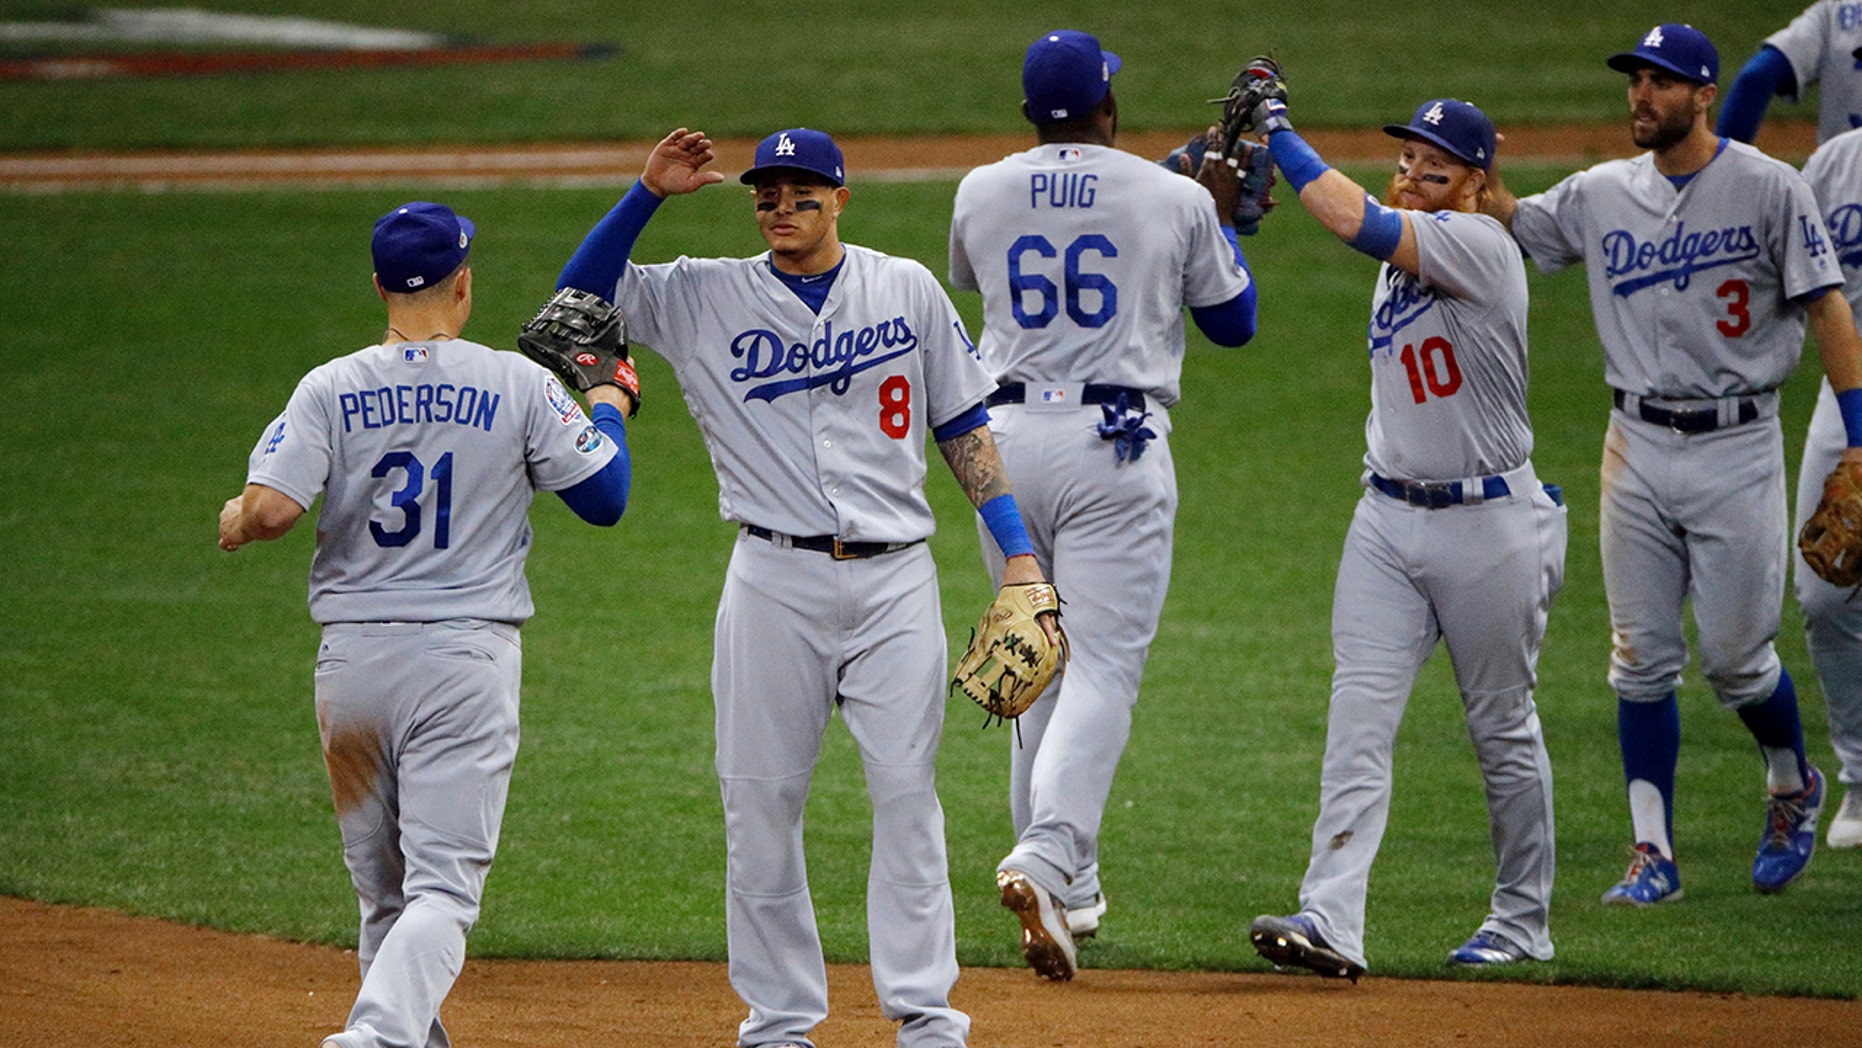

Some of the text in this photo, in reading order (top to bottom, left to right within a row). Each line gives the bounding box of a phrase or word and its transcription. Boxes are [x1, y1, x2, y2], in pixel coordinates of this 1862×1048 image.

[775, 132, 796, 156] LA
[1030, 173, 1099, 209] PUIG
[1602, 221, 1760, 298] Dodgers
[1798, 215, 1827, 257] LA
[1007, 233, 1118, 330] 66
[1716, 279, 1750, 337] 3
[730, 316, 918, 403] Dodgers
[1400, 336, 1463, 405] 10
[339, 383, 501, 433] PEDERSON
[878, 375, 911, 440] 8
[368, 451, 454, 550] 31
